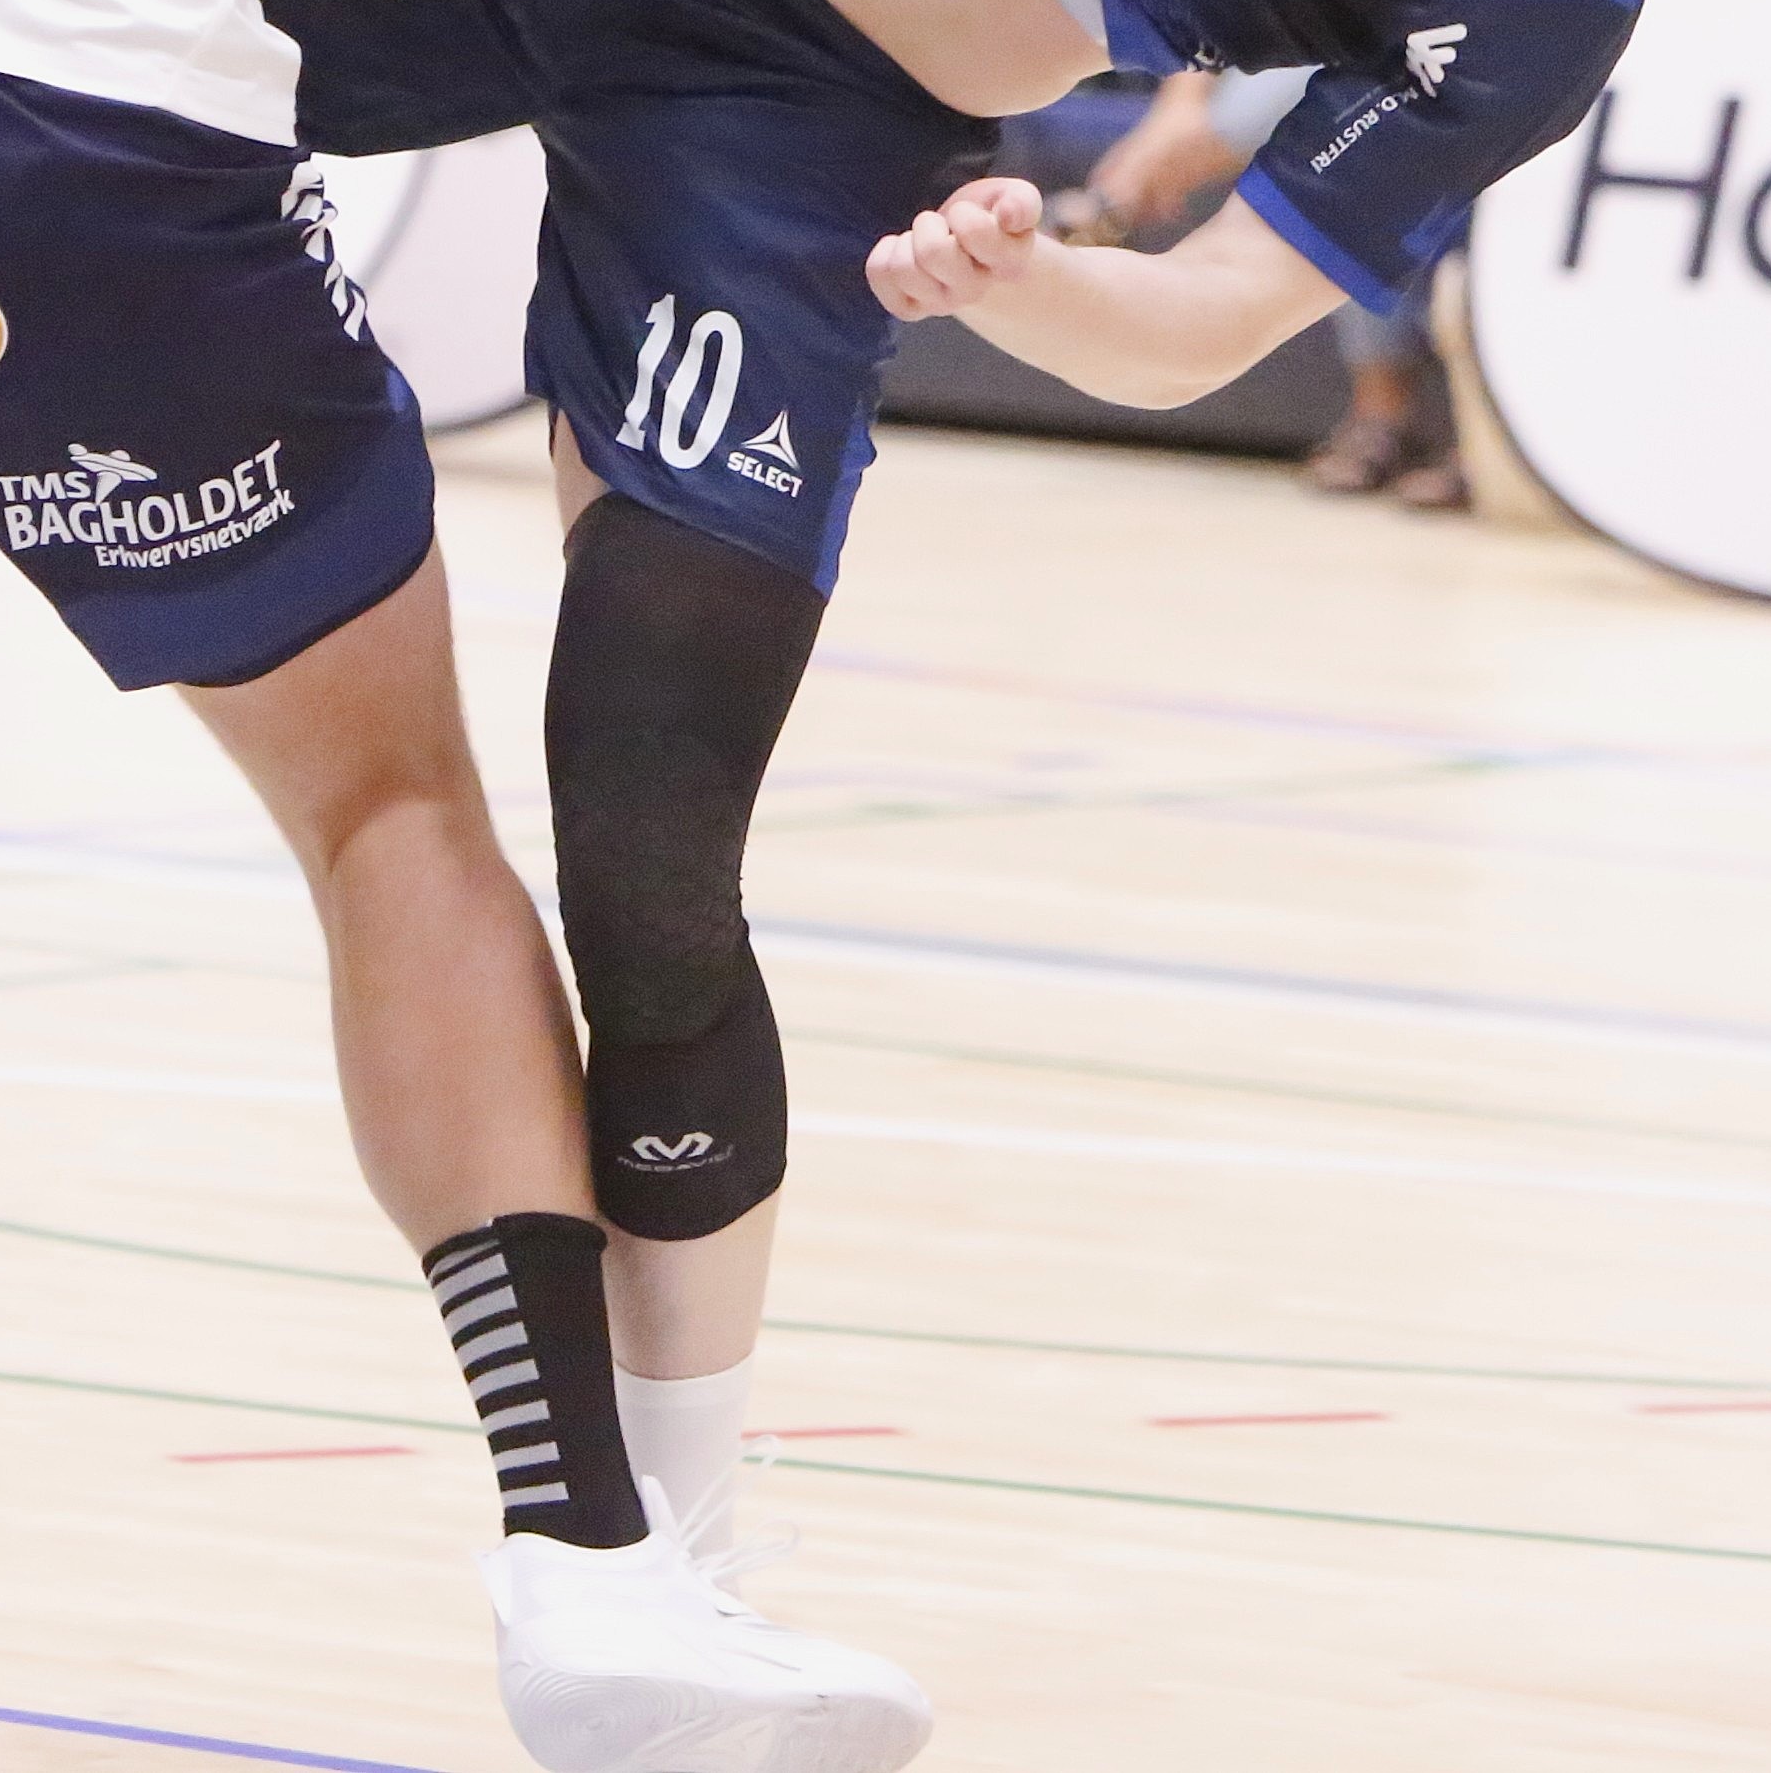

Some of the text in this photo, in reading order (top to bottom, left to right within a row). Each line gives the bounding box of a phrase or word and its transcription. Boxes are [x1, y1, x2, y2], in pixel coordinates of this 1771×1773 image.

[1309, 107, 1380, 175] RUSTFRI
[615, 292, 744, 470] 10
[3, 439, 282, 552] BAGHOLDET
[726, 450, 804, 498] SELECT
[94, 489, 296, 568] Erhvervsnetværk
